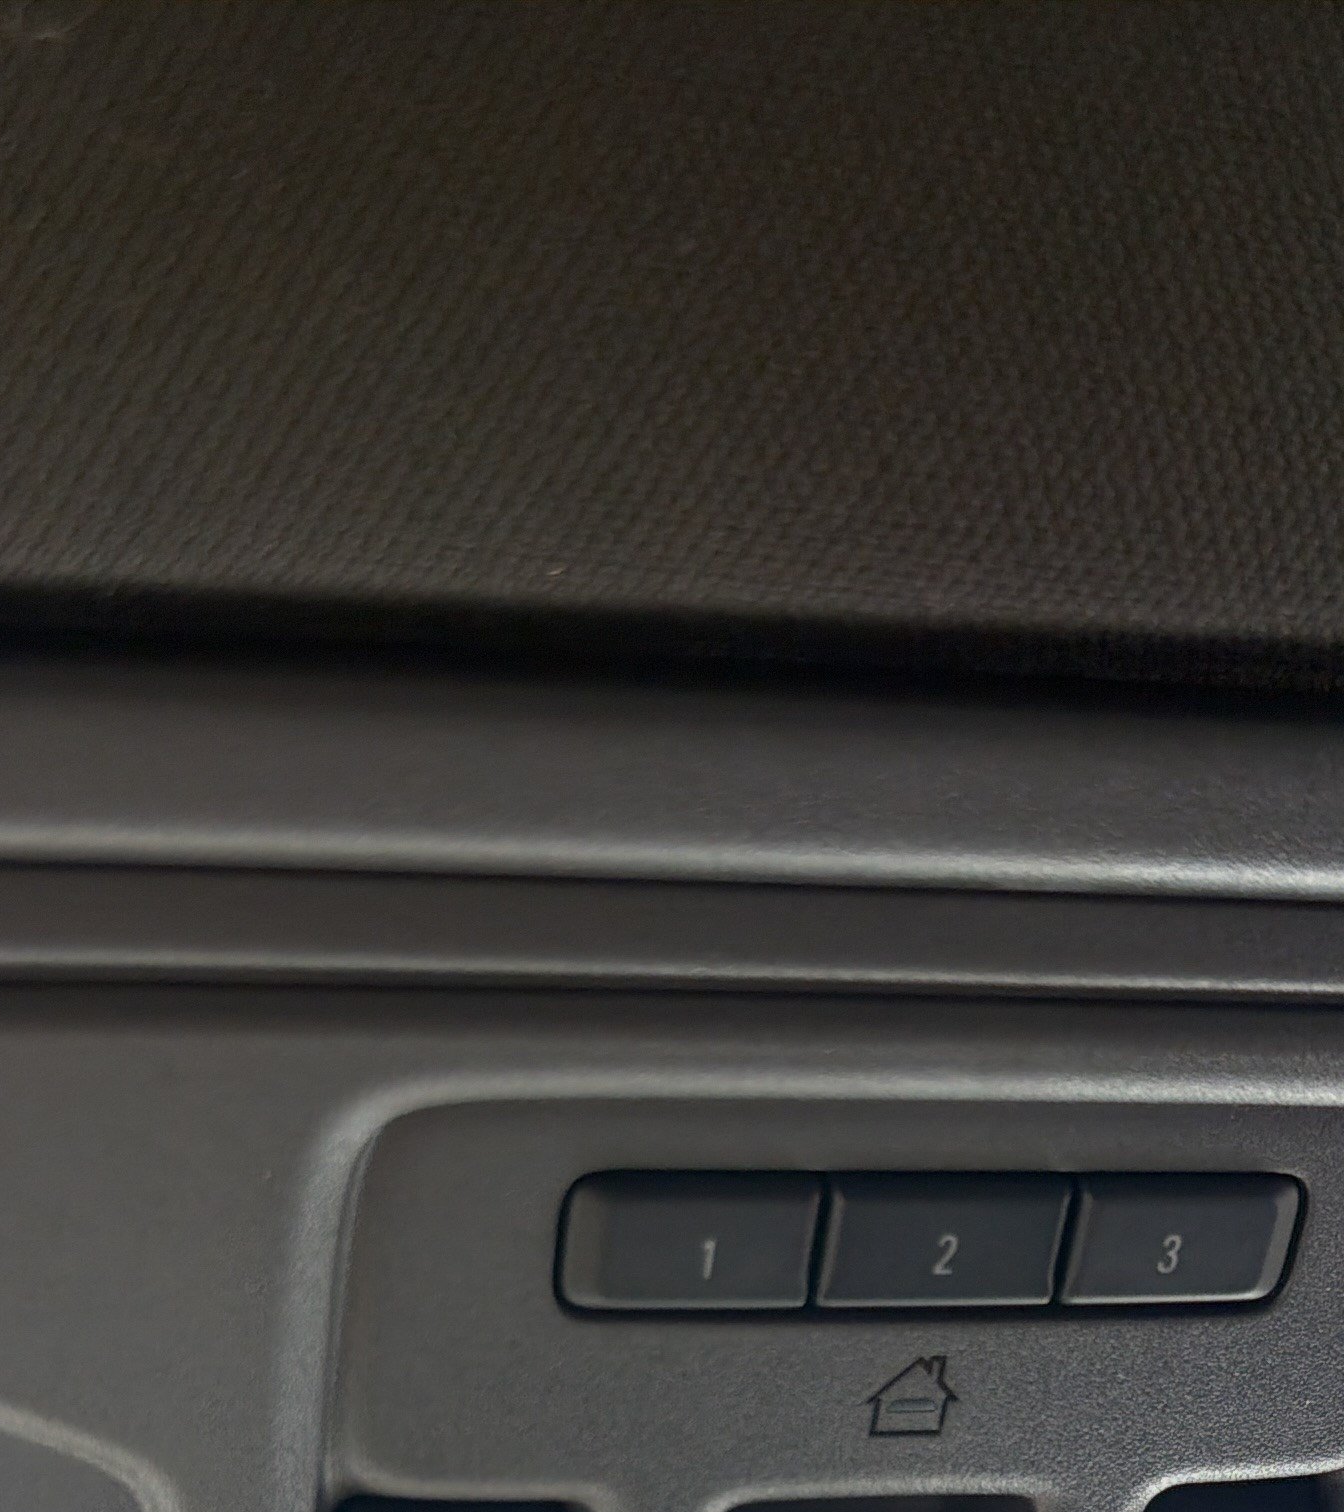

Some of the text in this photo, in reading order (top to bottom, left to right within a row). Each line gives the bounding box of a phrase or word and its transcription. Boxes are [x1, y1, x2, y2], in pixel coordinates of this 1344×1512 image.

[699, 1237, 719, 1281] 1
[931, 1234, 959, 1276] 2
[1156, 1234, 1183, 1274] 3
